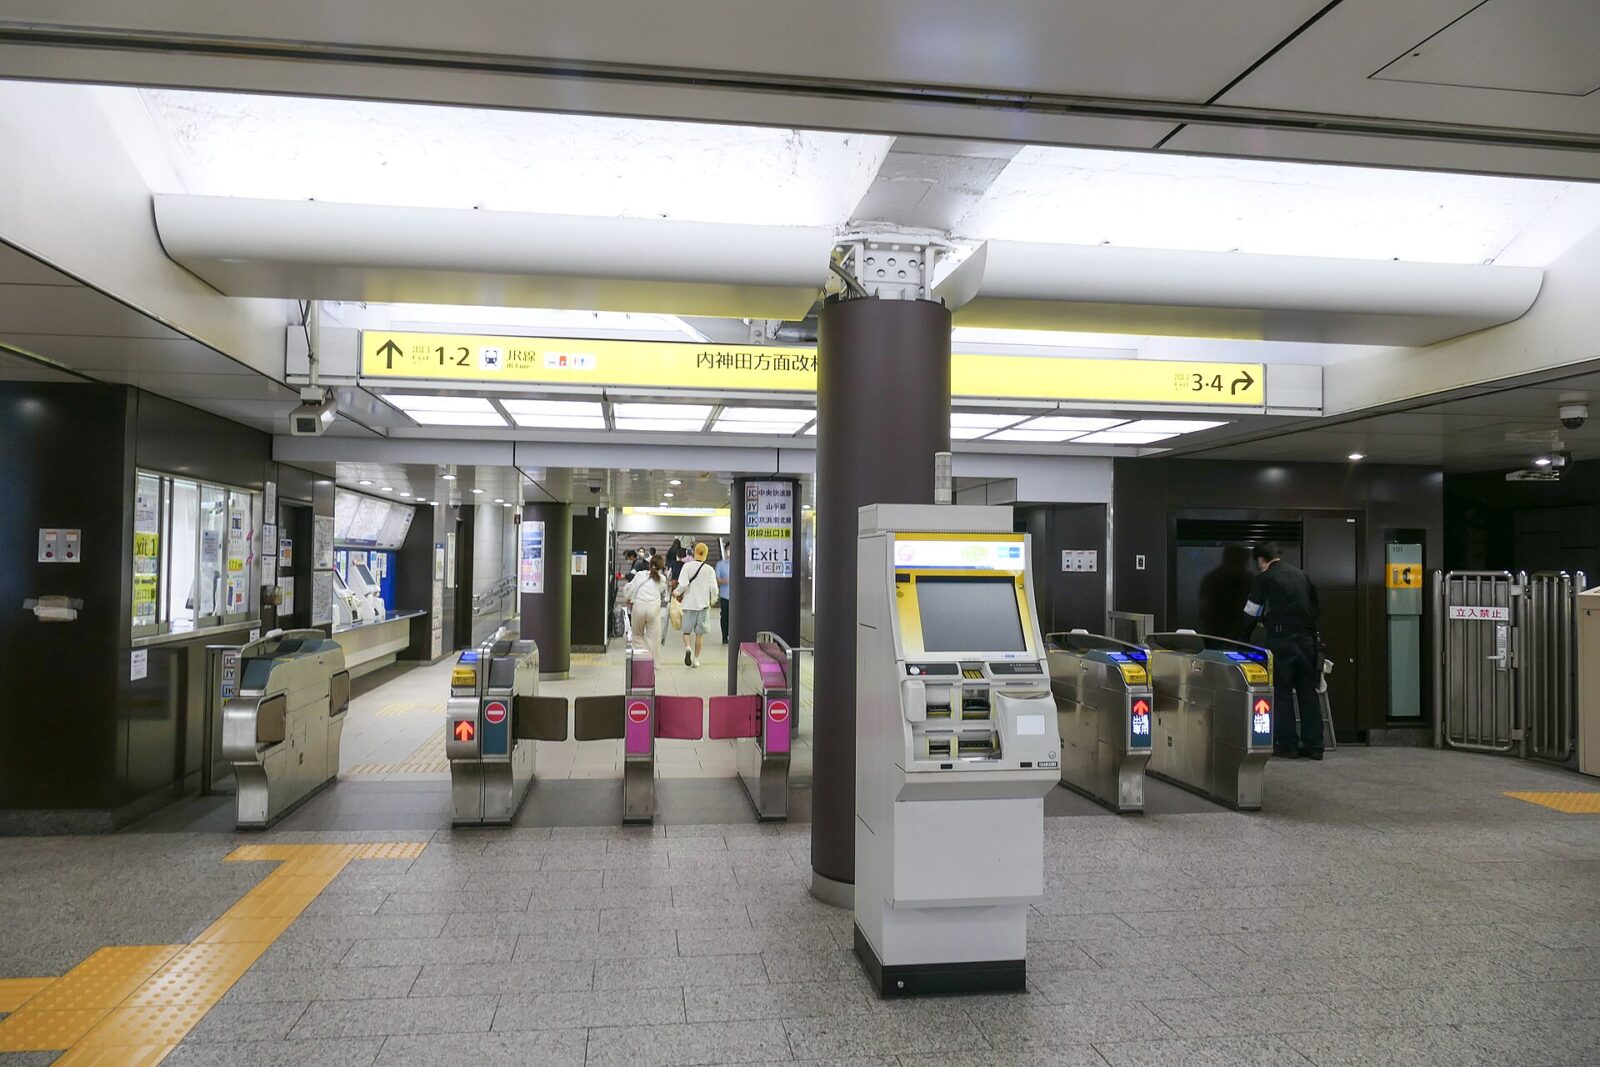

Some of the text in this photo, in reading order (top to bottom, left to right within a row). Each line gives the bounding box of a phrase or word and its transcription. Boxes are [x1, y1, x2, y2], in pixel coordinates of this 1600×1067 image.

[508, 350, 535, 362] JR線
[747, 489, 757, 498] JC
[748, 503, 757, 511] JY
[748, 516, 757, 525] JK
[135, 539, 147, 556] xit
[751, 547, 789, 561] Exit 1
[1456, 608, 1502, 618] 立入禁止
[225, 670, 234, 678] JY
